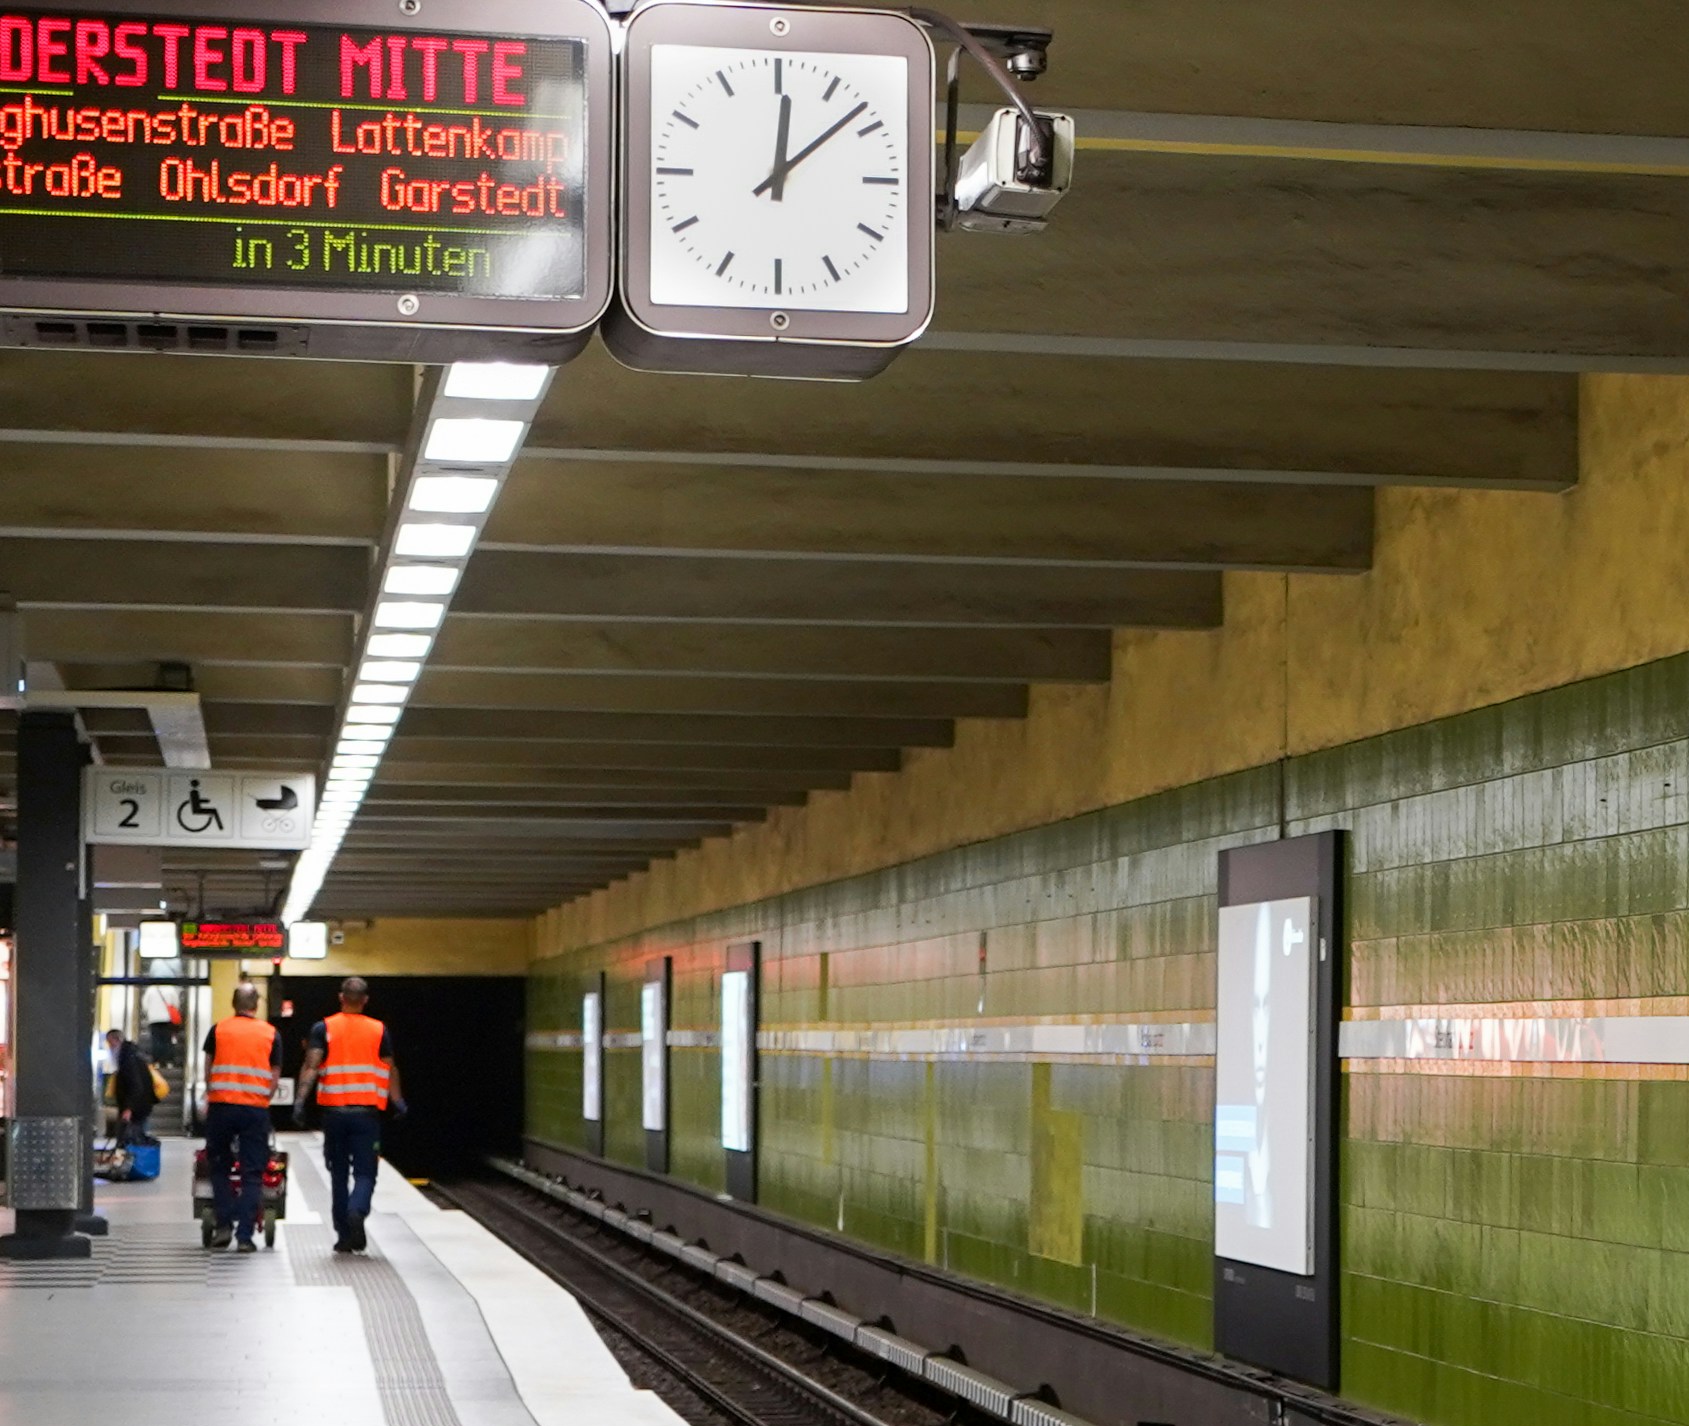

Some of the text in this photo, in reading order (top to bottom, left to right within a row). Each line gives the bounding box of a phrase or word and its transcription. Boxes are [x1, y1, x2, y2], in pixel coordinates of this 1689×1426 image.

[339, 33, 527, 106] MITTE
[330, 108, 569, 174] Lattenkamp
[0, 151, 565, 219] traße Ohlsdorf Garstedt
[232, 225, 491, 278] in 3 Minuten
[118, 798, 140, 829] 2
